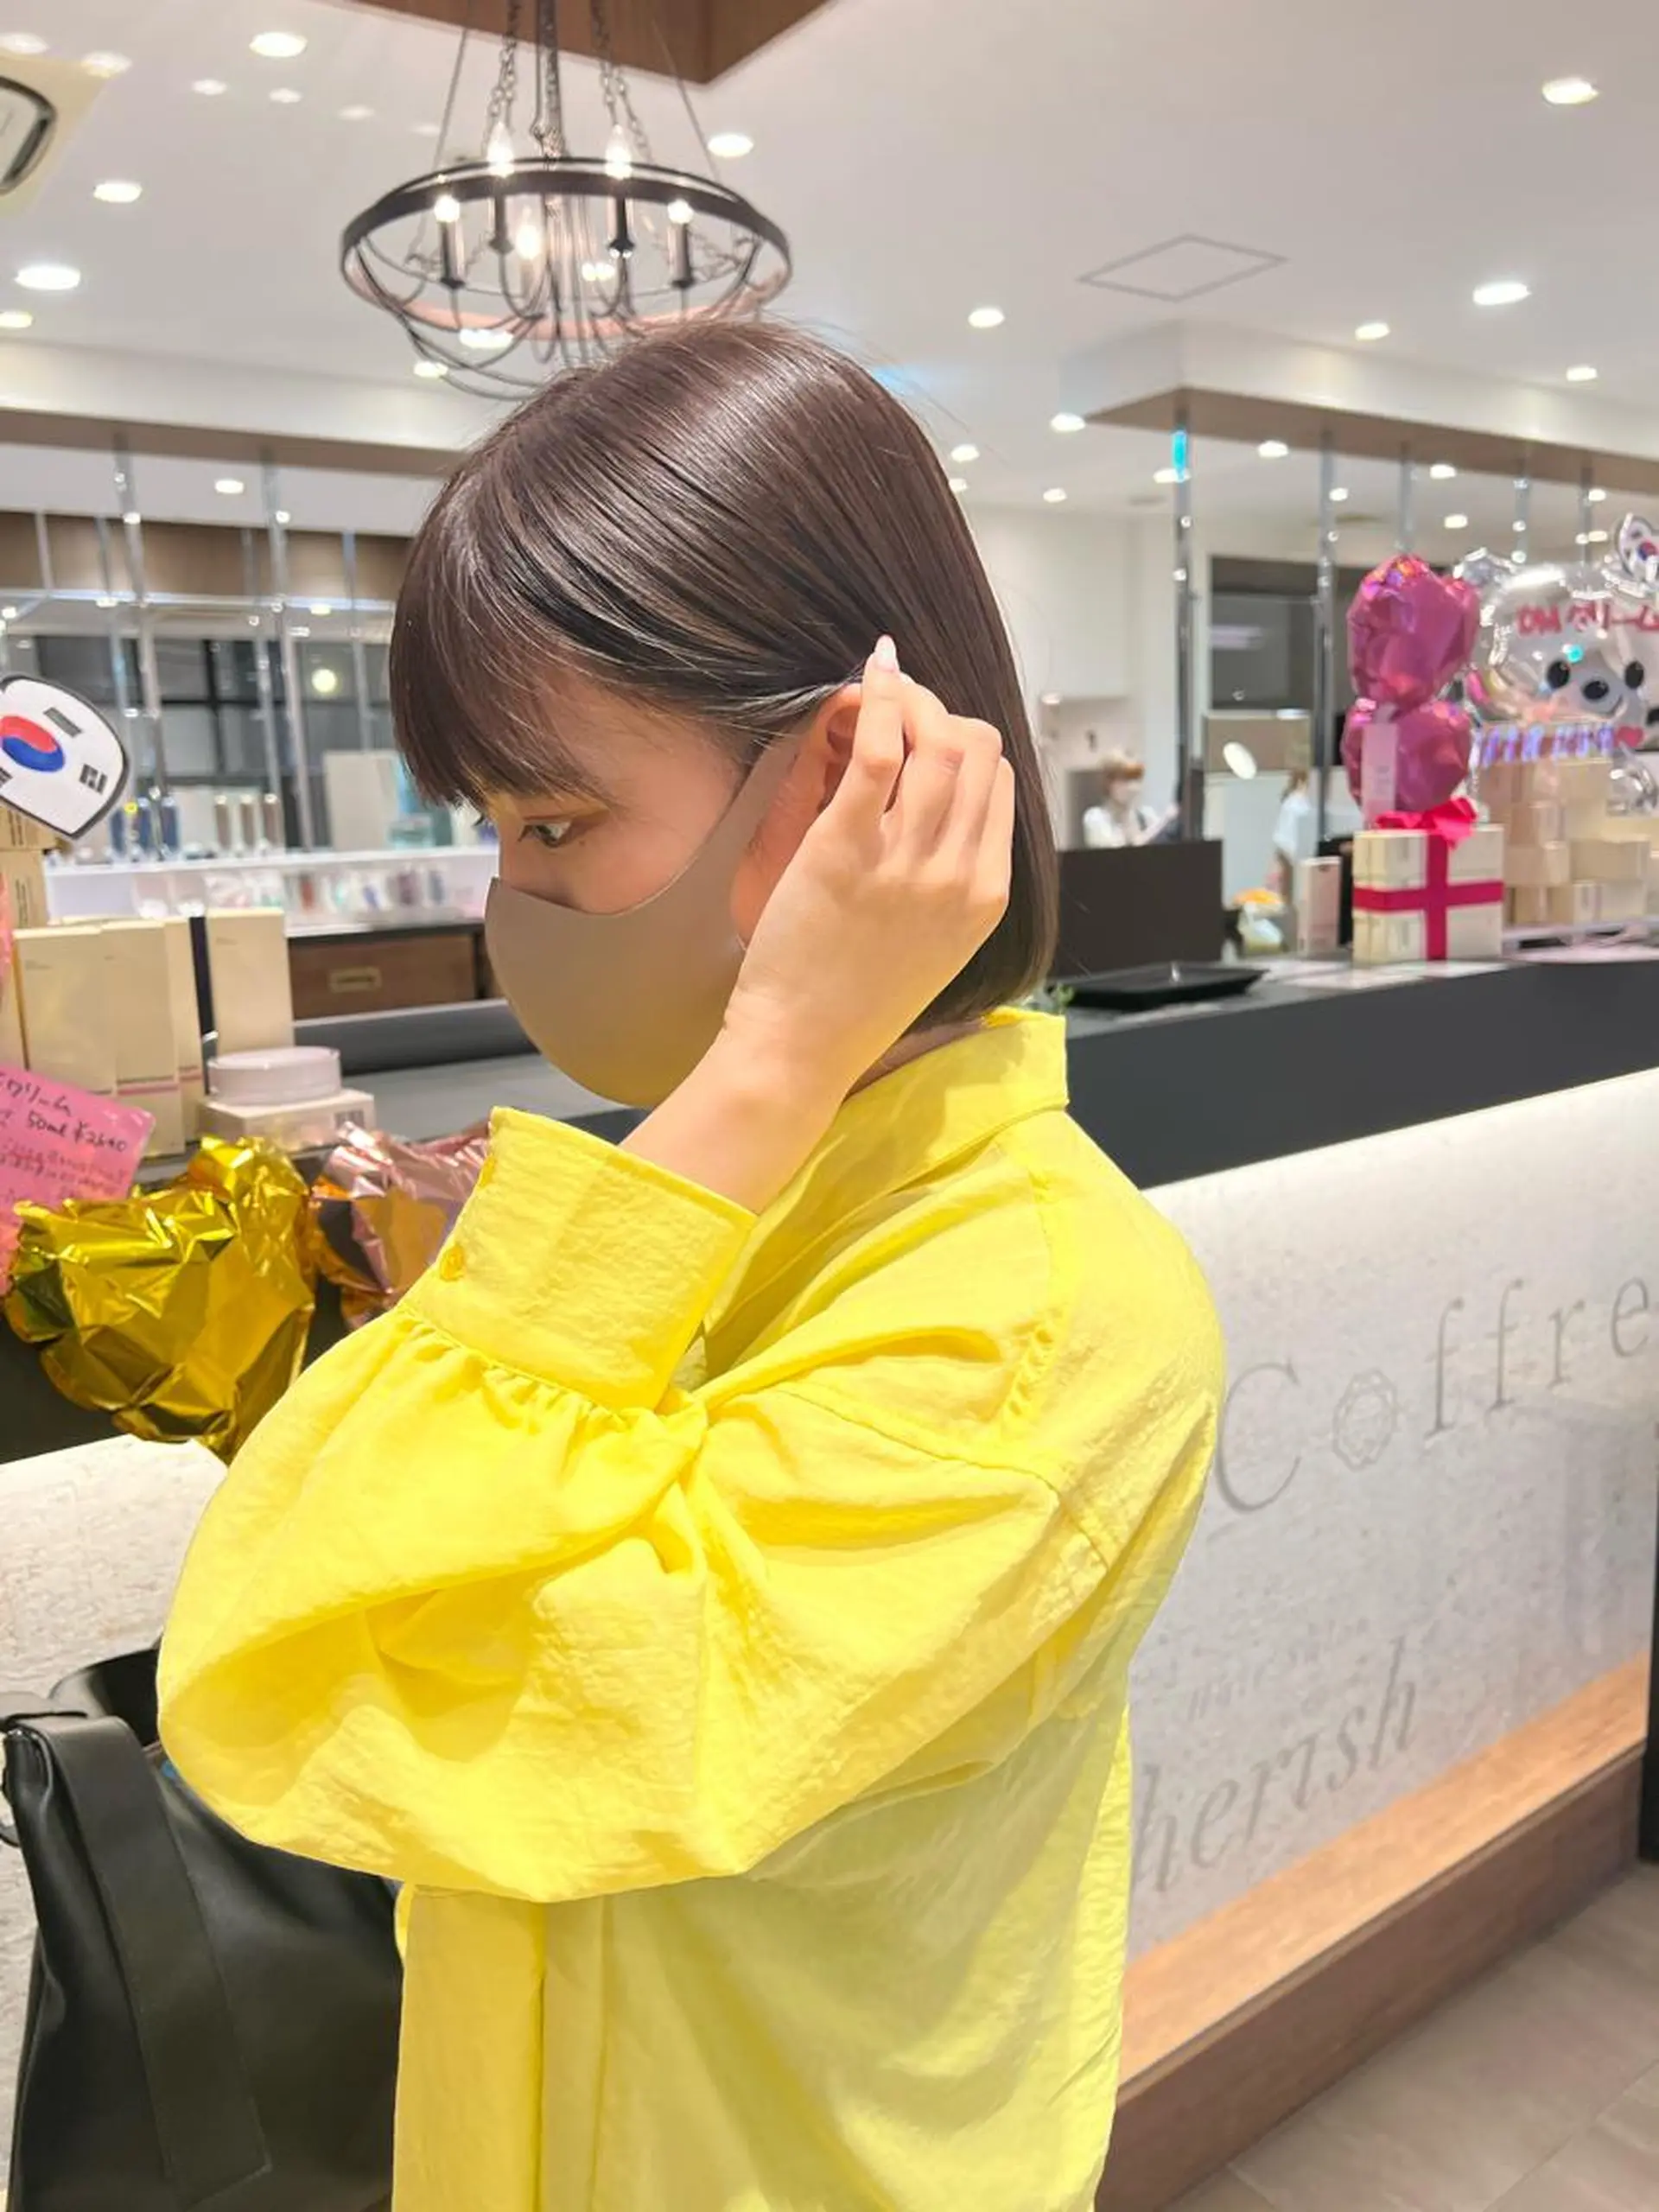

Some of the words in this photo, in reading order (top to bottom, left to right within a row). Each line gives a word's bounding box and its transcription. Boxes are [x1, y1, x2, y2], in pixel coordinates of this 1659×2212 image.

[0, 1071, 71, 1117] クリーム
[1131, 1636, 1416, 1892] herish
